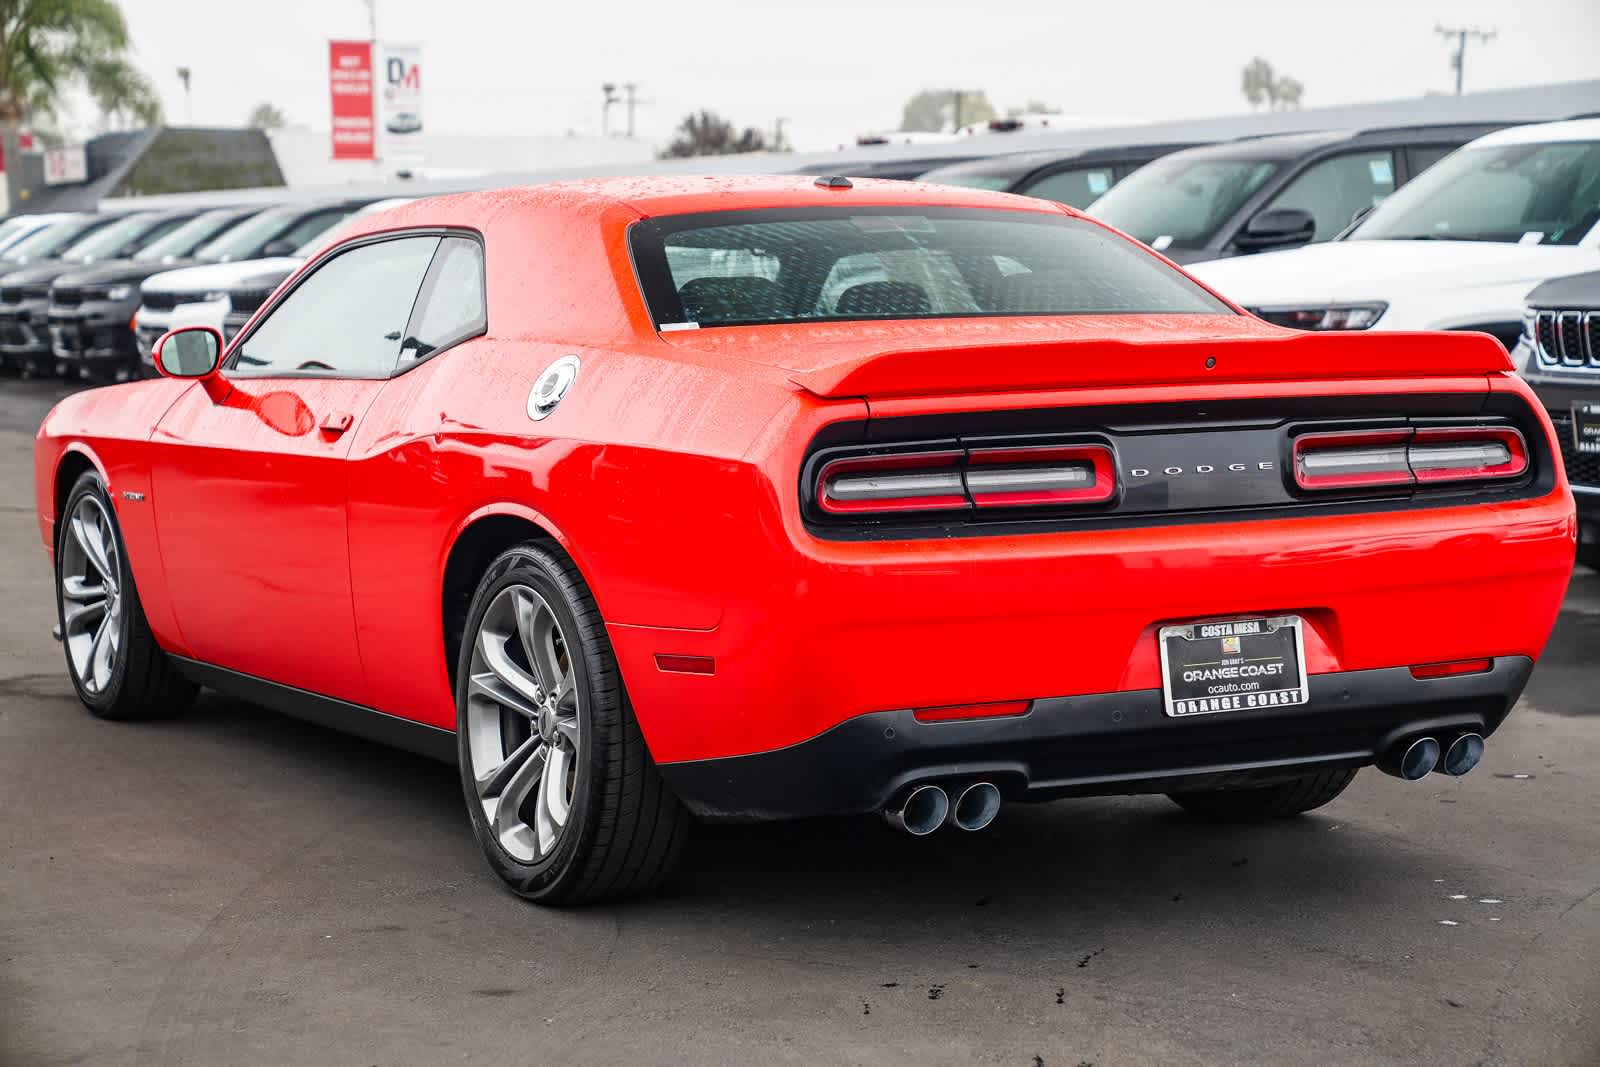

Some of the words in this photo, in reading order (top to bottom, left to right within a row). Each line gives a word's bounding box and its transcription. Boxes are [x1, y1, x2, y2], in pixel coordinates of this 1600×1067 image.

[1131, 461, 1273, 477] DODGE
[1201, 624, 1233, 637] COSTA
[1233, 621, 1260, 634] MESA
[1183, 667, 1239, 682] ORANGE
[1239, 663, 1284, 677] COAST
[1208, 682, 1260, 694] ocauto.com
[1176, 697, 1241, 714] ORANGE
[1247, 690, 1299, 707] COAST
